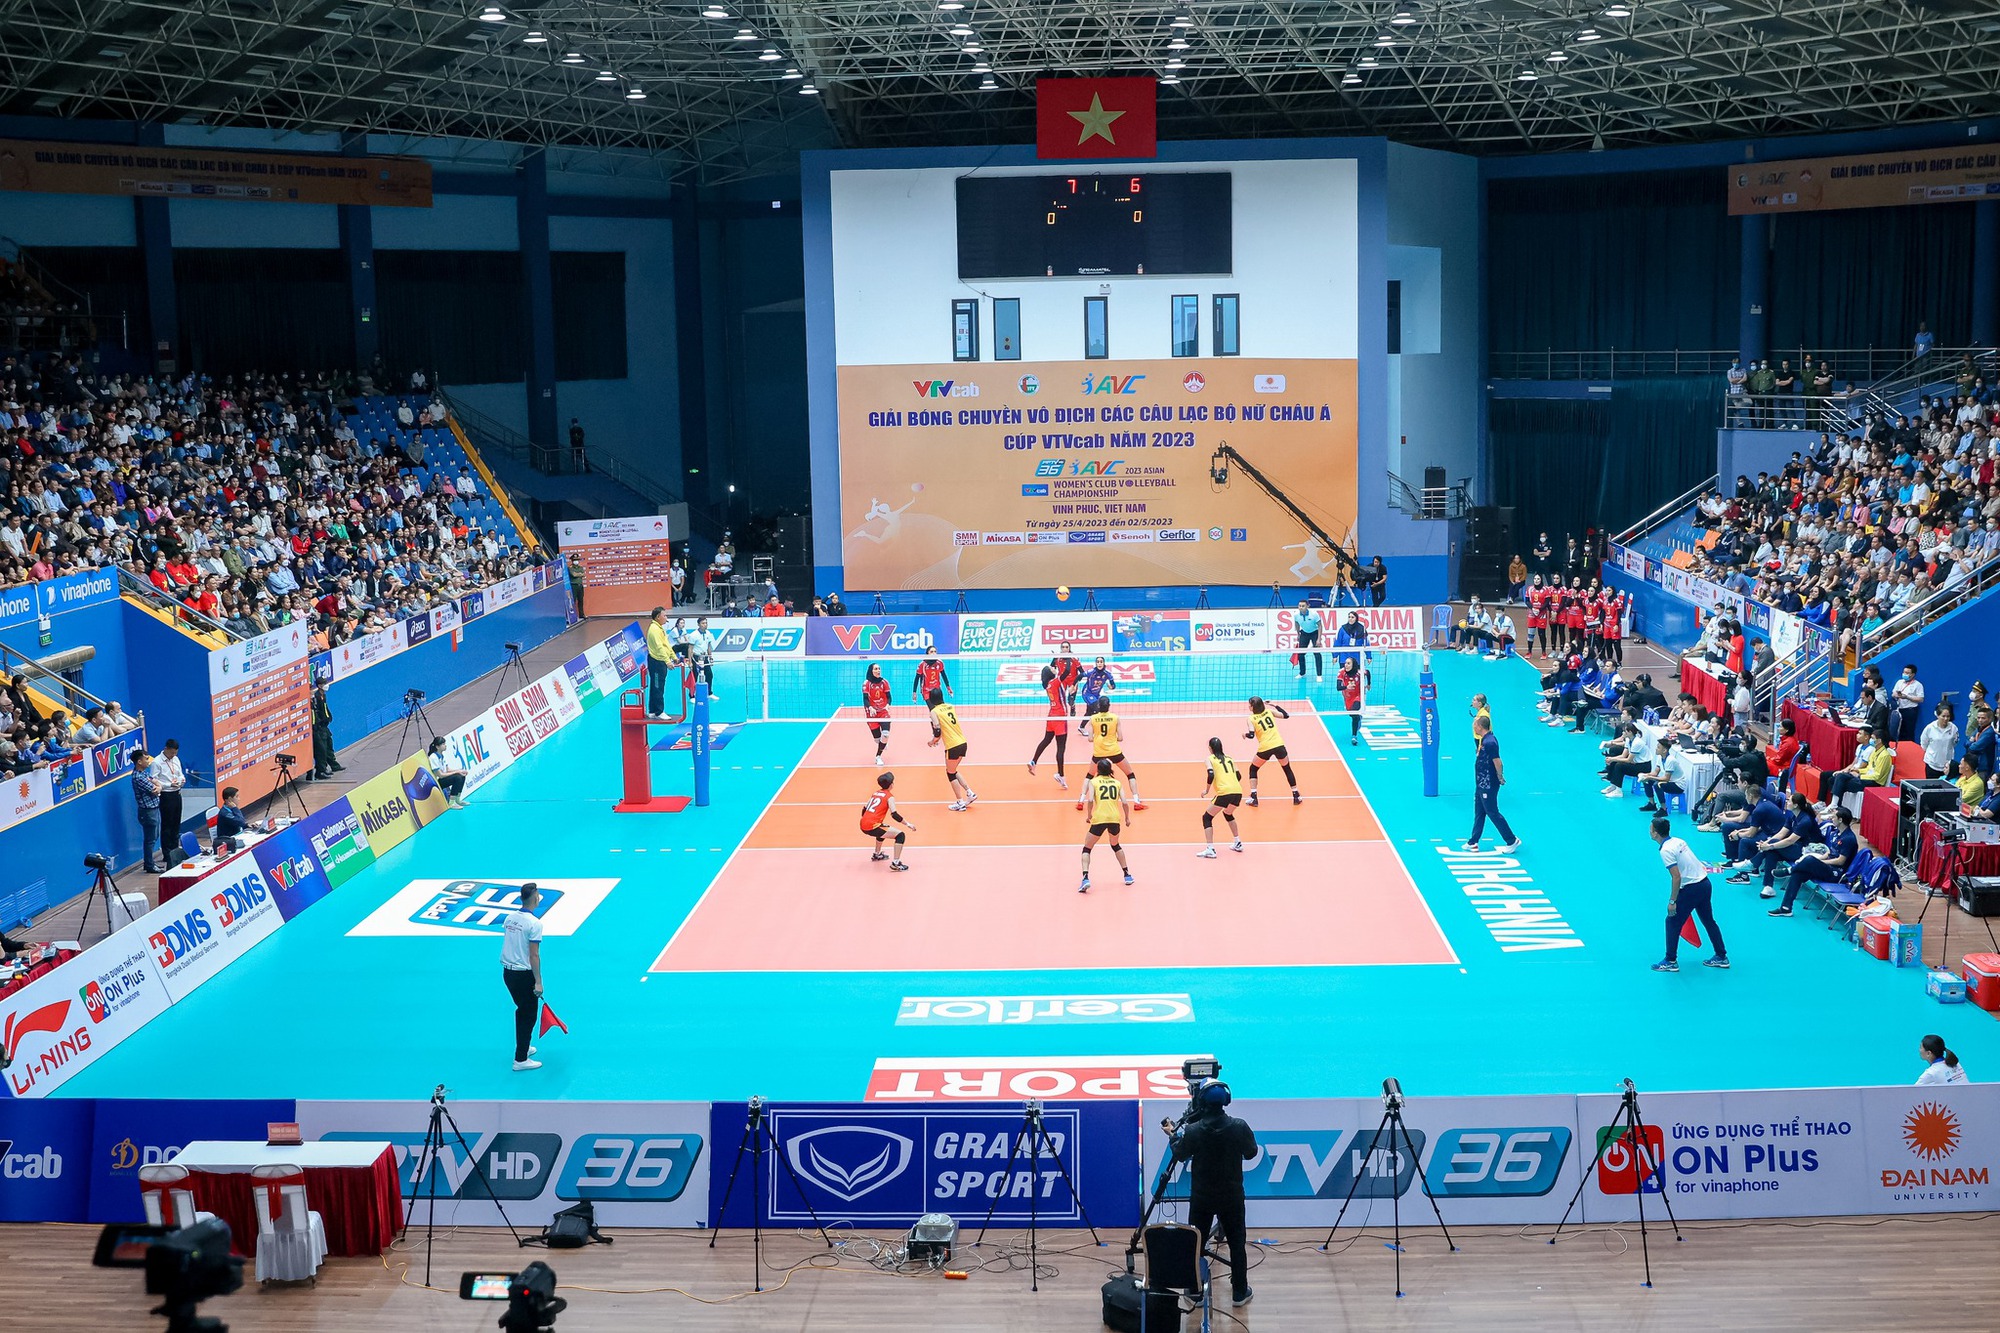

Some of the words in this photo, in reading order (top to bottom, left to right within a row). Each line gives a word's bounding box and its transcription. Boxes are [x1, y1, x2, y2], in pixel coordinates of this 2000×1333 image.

[1068, 180, 1076, 194] 7
[1130, 178, 1140, 192] 6
[1047, 212, 1055, 224] 0
[1134, 210, 1142, 222] 0
[913, 380, 980, 398] VTVcab
[1094, 375, 1146, 394] AVC
[868, 408, 902, 426] GIẢI
[908, 409, 952, 426] BÓNG
[958, 404, 1022, 426] CHUYỀN
[1027, 406, 1049, 424] VÔ
[1055, 408, 1095, 426] ĐỊCH
[1101, 404, 1134, 422] CÁC
[1140, 404, 1173, 422] CÂU
[1179, 405, 1208, 424] LẠC
[1214, 403, 1236, 424] BỘ
[1242, 403, 1267, 421] NỮ
[1270, 403, 1314, 421] CHÂU
[1320, 403, 1331, 421] Á
[1004, 432, 1037, 450] CÚP
[1042, 434, 1105, 450] VTVcab
[1110, 430, 1146, 448] NĂM
[1152, 432, 1195, 447] 2023
[1080, 460, 1125, 475] AVC
[1054, 480, 1092, 489] WOMEN'S
[1095, 479, 1116, 488] CLUB
[1054, 490, 1118, 498] CHAMPIONSHIP
[1052, 505, 1073, 514] VINH
[1105, 504, 1123, 513] VIET
[1126, 504, 1146, 513] NAM
[1026, 520, 1037, 528] Từ
[1039, 520, 1060, 529] ngày
[1063, 519, 1108, 527] 25/4/2023
[1109, 518, 1126, 526] đến
[1127, 518, 1172, 526] 02/5/2023
[986, 534, 1021, 542] MIKASA
[1160, 530, 1195, 540] Gerflor
[60, 576, 112, 602] vinaphone
[0, 597, 30, 618] hone
[1277, 610, 1337, 631] SM
[1358, 610, 1414, 630] SMM
[726, 635, 746, 645] HD
[758, 630, 796, 647] 36
[832, 624, 934, 651] VTVcab
[963, 627, 995, 640] EURO
[1001, 626, 1032, 639] EURO
[1045, 628, 1105, 641] ISUZU
[1215, 629, 1231, 637] ON
[1234, 628, 1255, 636] Plus
[1369, 634, 1414, 648] PORT
[962, 638, 993, 649] CAKE
[999, 637, 1030, 648] CAKE
[1162, 636, 1185, 651] TS
[495, 698, 524, 733] SMM
[521, 683, 549, 716] SMM
[948, 712, 956, 725] 3
[1258, 716, 1274, 731] 19
[506, 726, 534, 756] SPORT
[533, 711, 558, 738] SPORT
[1100, 724, 1108, 737] 9
[463, 724, 490, 770] AVC
[73, 777, 85, 794] TS
[1100, 785, 1117, 800] 20
[866, 798, 881, 813] 12
[360, 796, 408, 836] MIKASA
[322, 820, 346, 841] Salonpas
[270, 854, 314, 890] VTVcab
[124, 955, 133, 968] THỂ
[131, 950, 146, 963] THAO
[191, 950, 204, 962] Medical
[203, 941, 219, 955] Services
[86, 989, 105, 1012] ON
[105, 981, 124, 1002] ON
[122, 969, 145, 991] Plus
[120, 990, 140, 1007] vinaphone
[900, 998, 1191, 1023] Gerflor
[12, 1026, 92, 1096] LI-NING
[875, 1069, 1192, 1099] SPORT
[1672, 1122, 1710, 1140] ỨNG
[1715, 1121, 1765, 1143] DỤNG
[1770, 1116, 1800, 1137] THỂ
[1805, 1121, 1852, 1136] THAO
[933, 1132, 1066, 1160] GRAND
[490, 1151, 541, 1179] HD
[578, 1138, 684, 1188] 36
[1352, 1149, 1406, 1178] HD
[1444, 1132, 1552, 1182] 36
[1602, 1142, 1660, 1173] ON
[1672, 1145, 1729, 1175] ON
[1744, 1144, 1819, 1173] Plus
[934, 1170, 1063, 1198] SPORT
[1675, 1180, 1695, 1193] for
[1701, 1178, 1780, 1194] vinaphone
[1880, 1168, 1926, 1190] ĐẠI
[1930, 1167, 1990, 1186] NAM
[1894, 1191, 1980, 1201] UNIVERSITY
